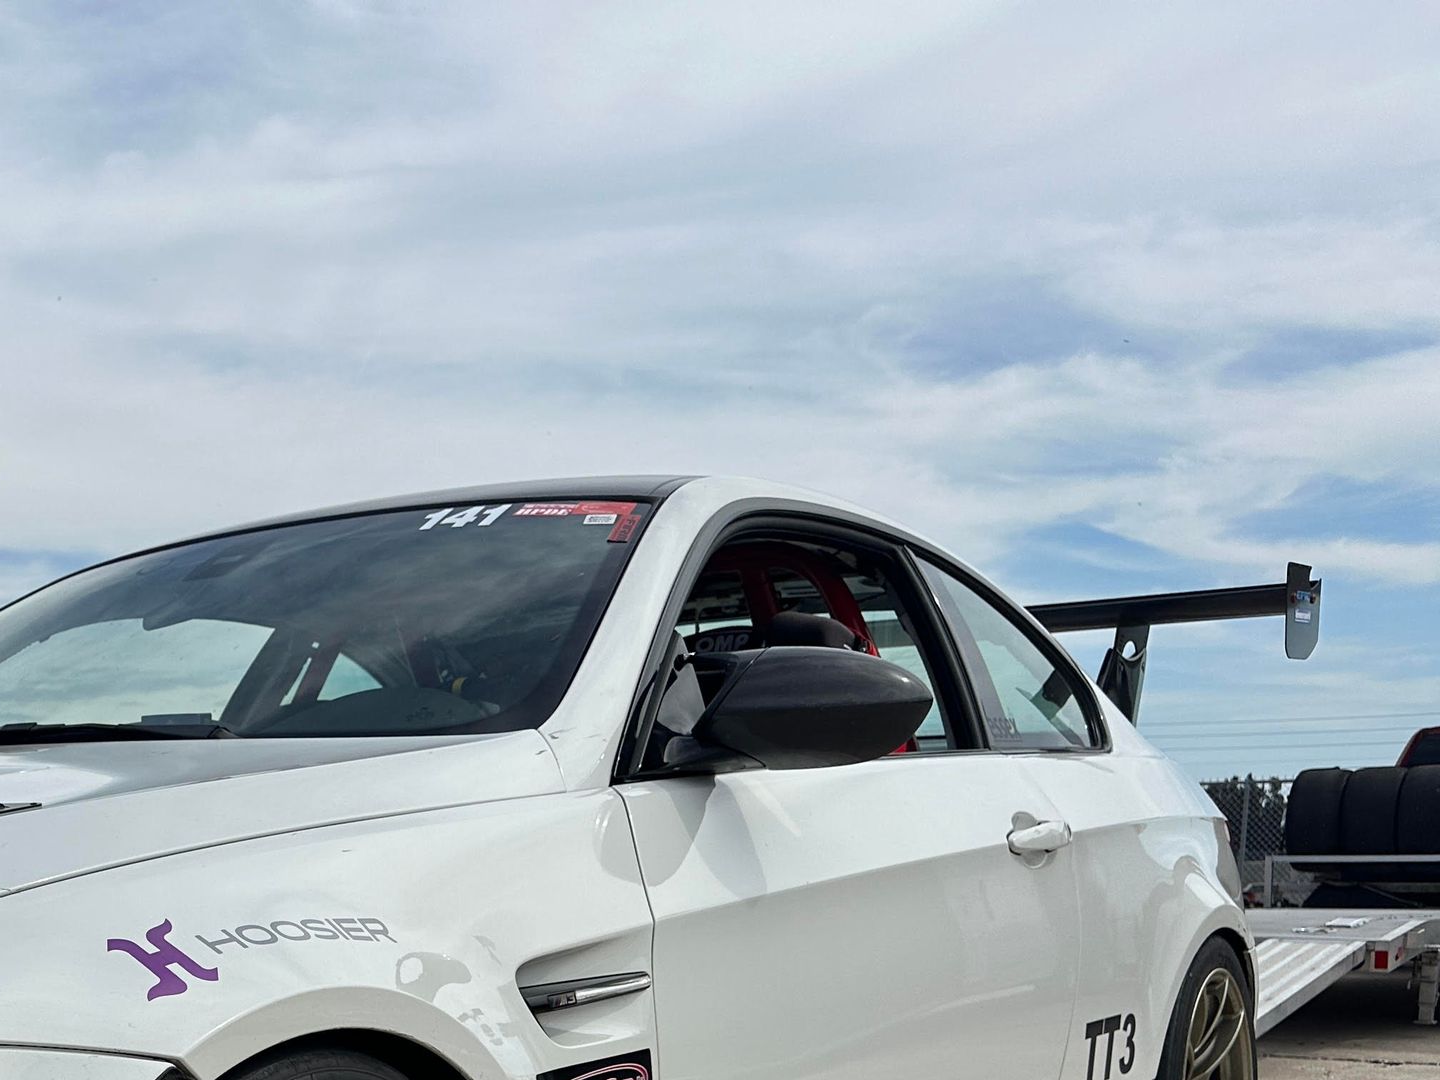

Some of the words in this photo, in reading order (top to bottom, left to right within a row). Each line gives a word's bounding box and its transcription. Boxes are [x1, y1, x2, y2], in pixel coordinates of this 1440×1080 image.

[418, 504, 513, 531] 141
[695, 633, 750, 653] OMP
[195, 918, 398, 955] HOOSIER
